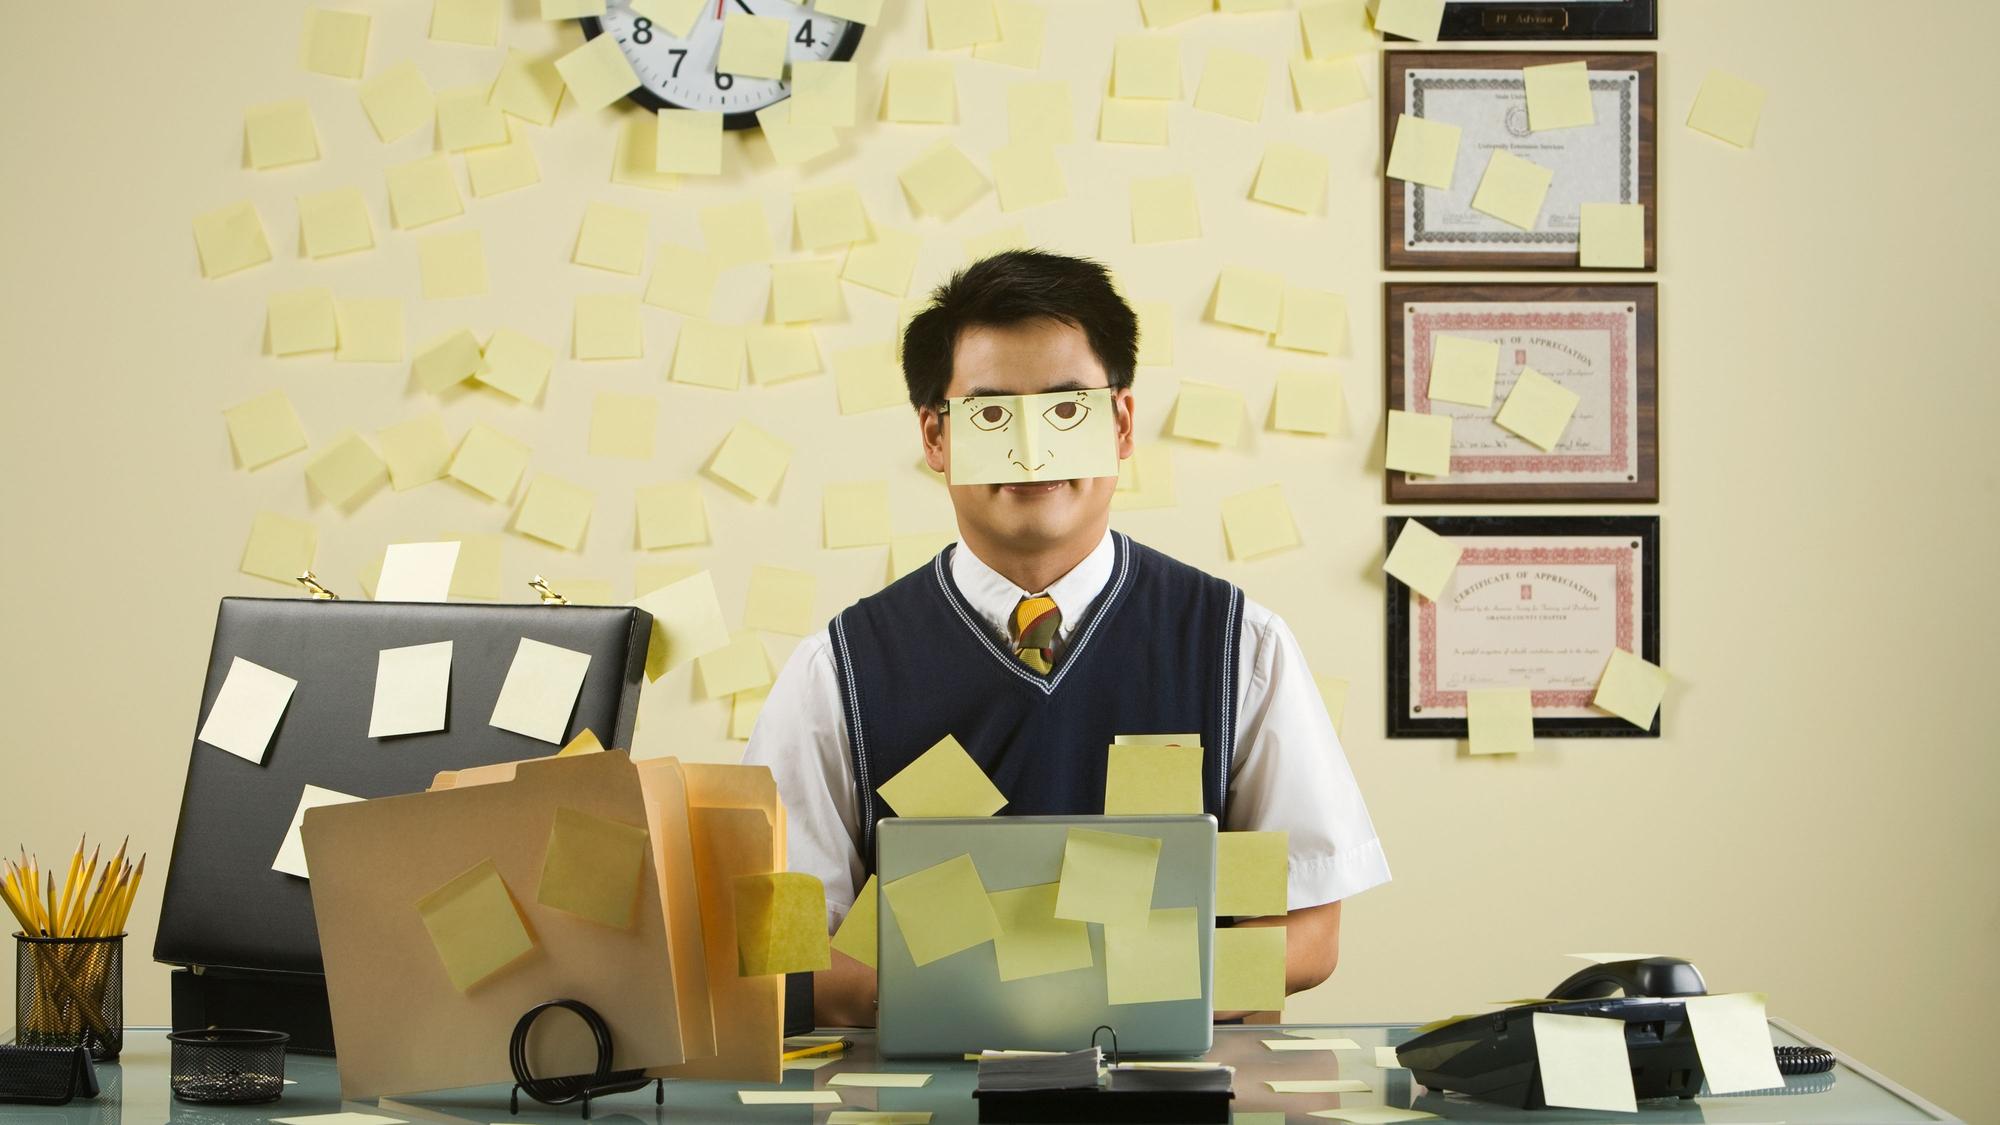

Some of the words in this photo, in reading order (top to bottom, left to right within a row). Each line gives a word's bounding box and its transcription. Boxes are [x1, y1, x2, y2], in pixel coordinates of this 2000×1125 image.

[632, 17, 653, 45] 8
[794, 19, 816, 48] 4
[668, 49, 688, 79] 7
[714, 66, 734, 91] 6
[1510, 336, 1521, 345] OF
[1529, 337, 1592, 368] APPRECIATION
[1454, 572, 1510, 604] CERTIFICATE
[1516, 571, 1528, 579] OF
[1535, 572, 1598, 602] APPRECIATION
